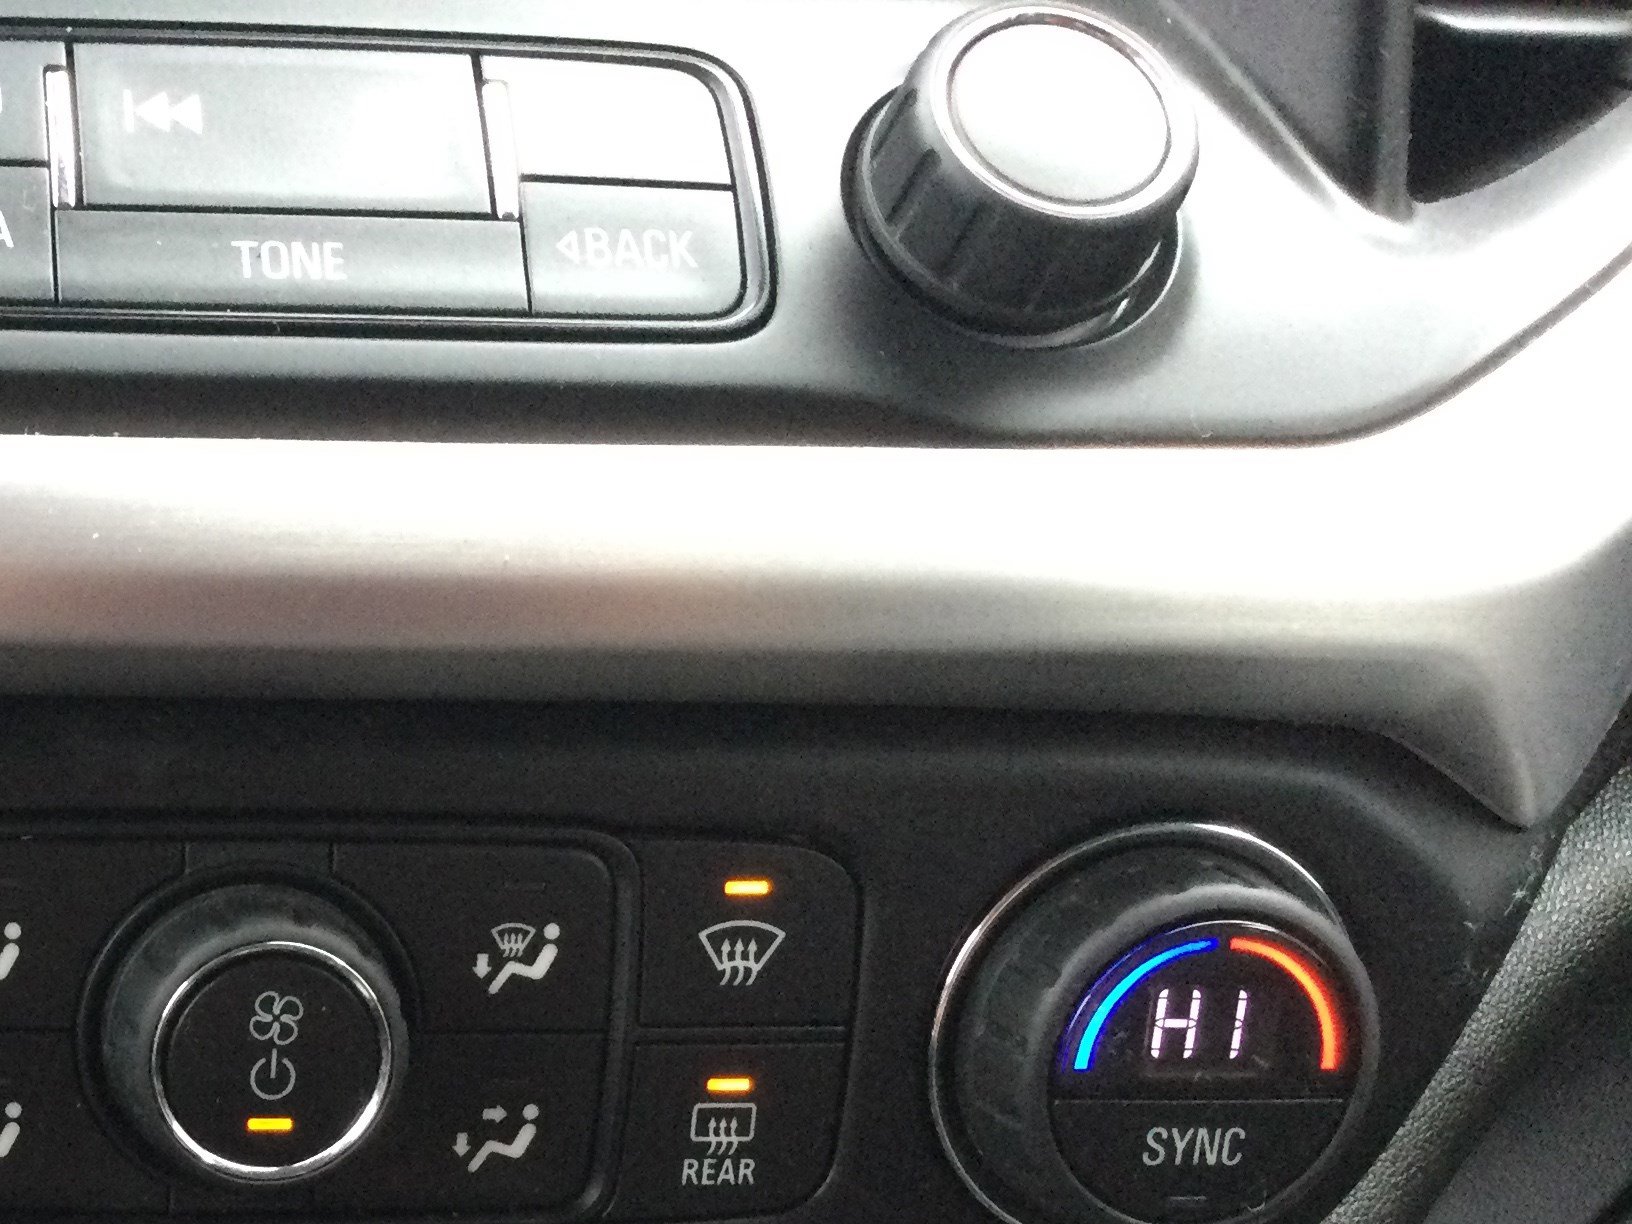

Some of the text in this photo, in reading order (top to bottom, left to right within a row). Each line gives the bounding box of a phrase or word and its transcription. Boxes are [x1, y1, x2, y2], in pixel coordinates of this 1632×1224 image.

[230, 240, 348, 280] TONE
[583, 226, 699, 269] BACK
[1150, 988, 1248, 1059] HI
[1142, 1126, 1246, 1166] SYNC
[681, 1158, 756, 1186] REAR
